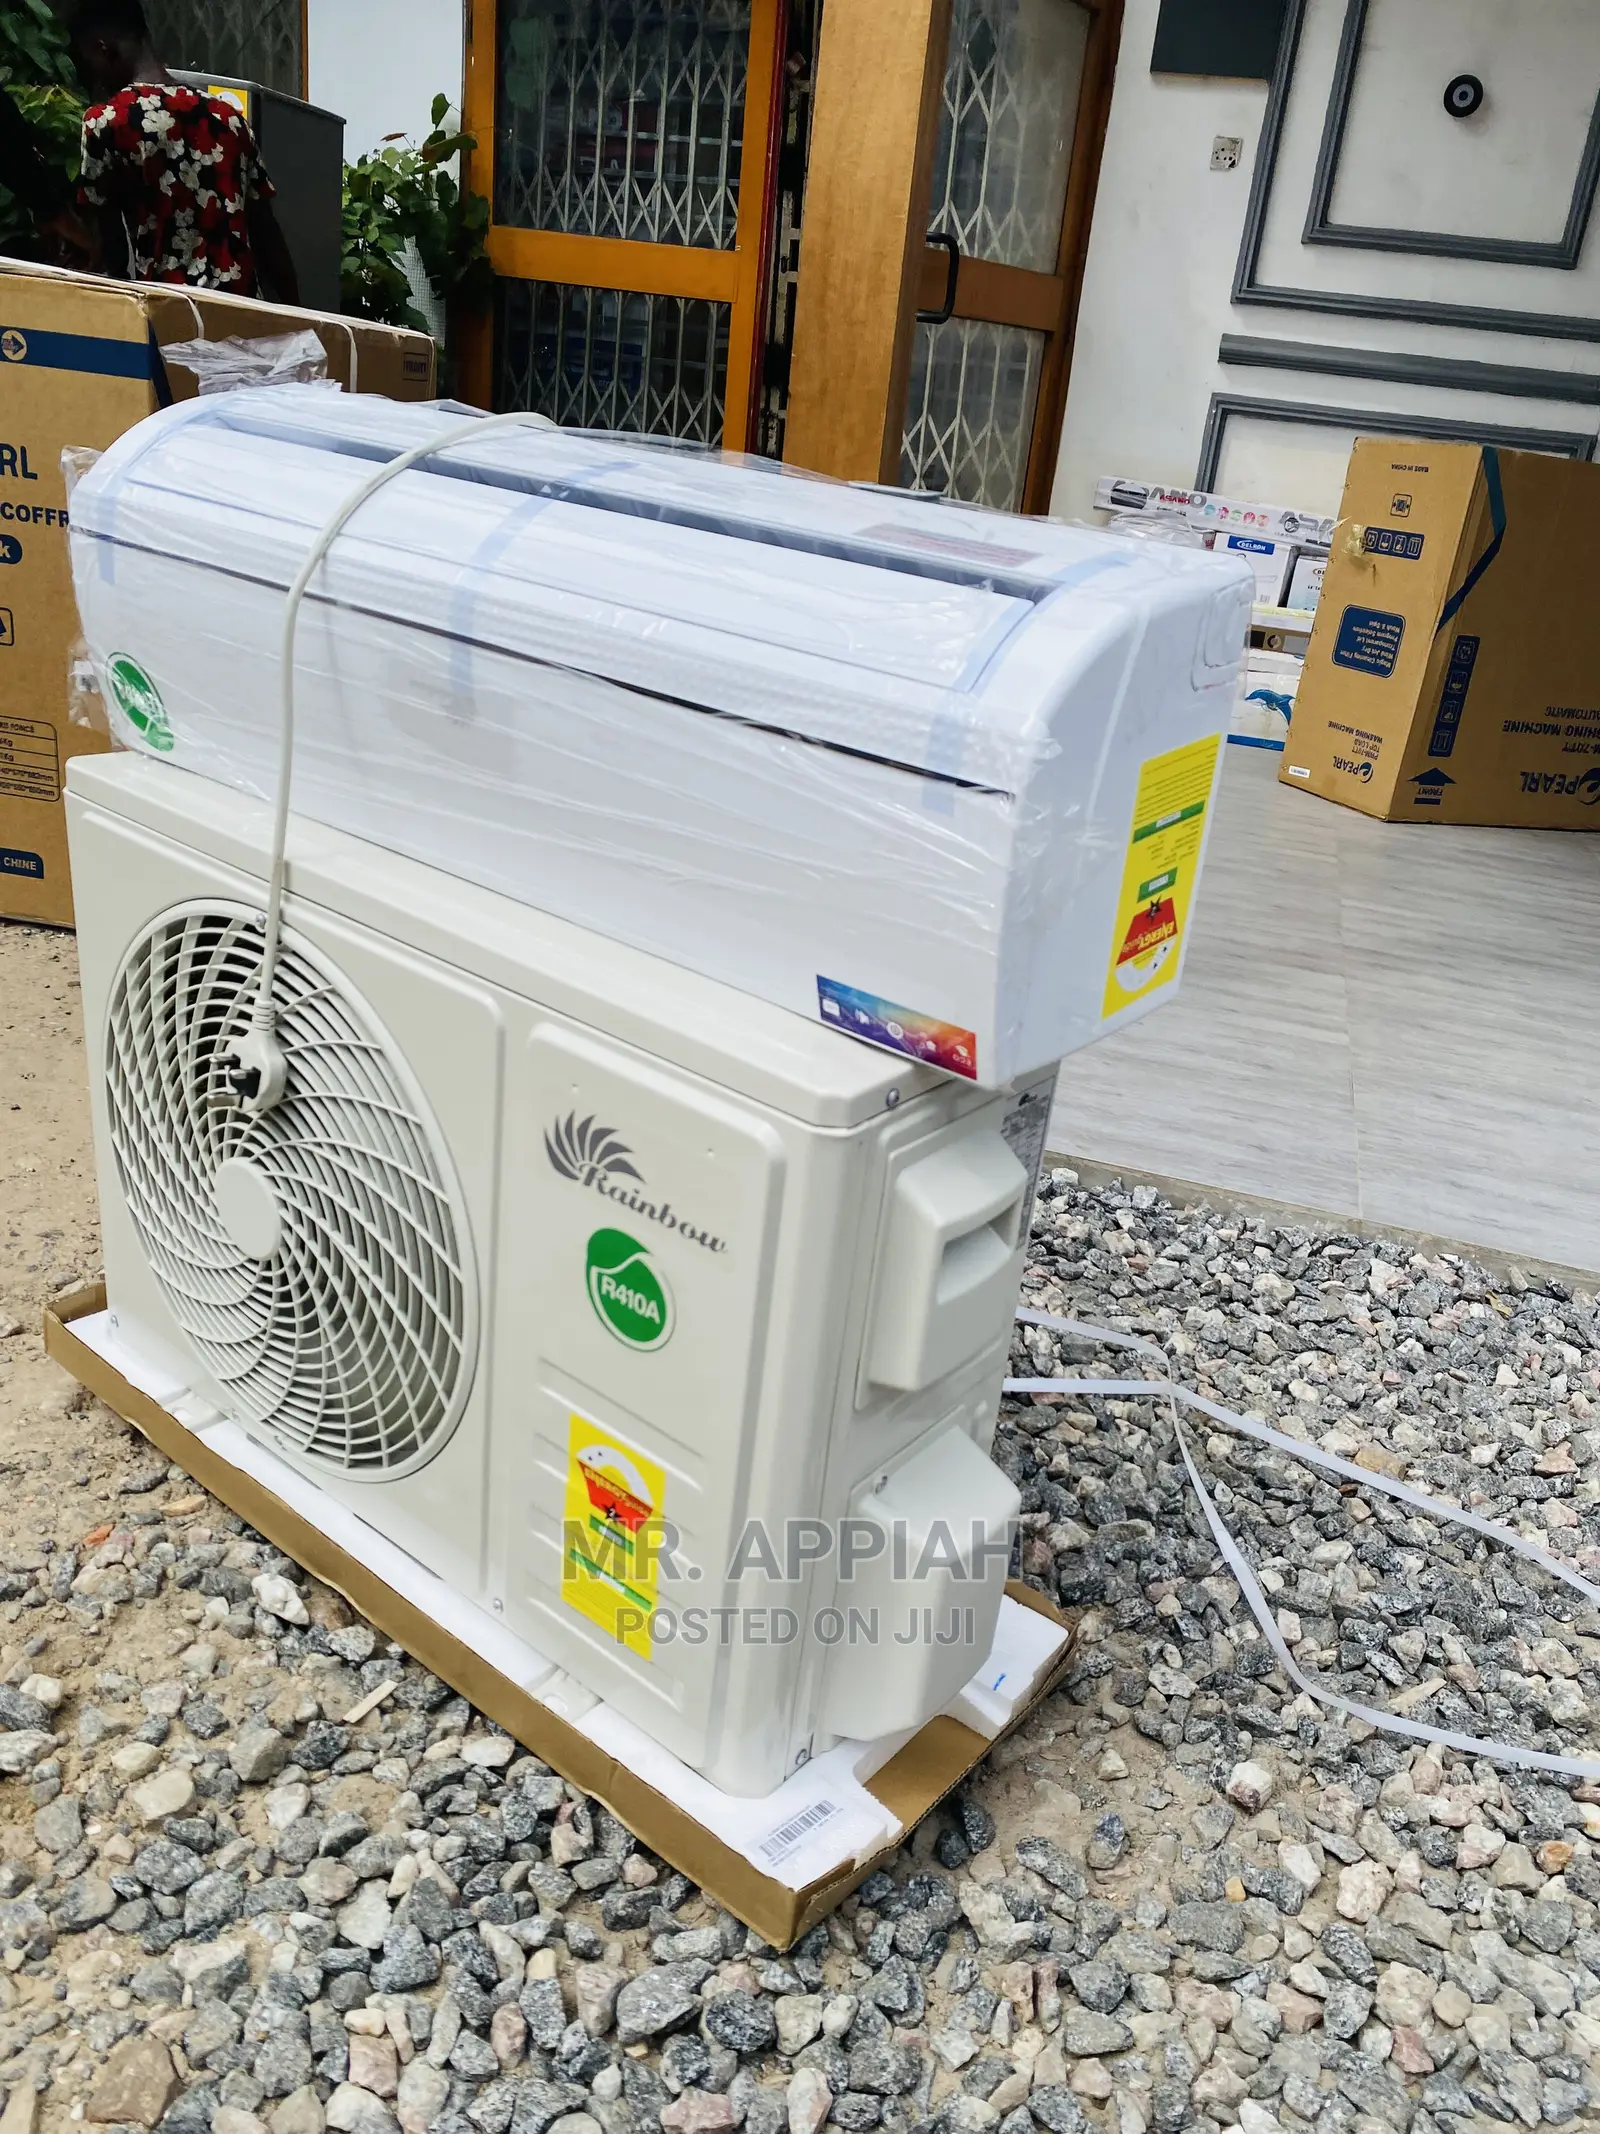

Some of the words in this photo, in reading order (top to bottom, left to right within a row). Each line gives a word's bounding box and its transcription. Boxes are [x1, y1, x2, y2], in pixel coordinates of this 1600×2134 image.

[1391, 463, 1407, 471] CHINA
[1414, 465, 1429, 473] MADE
[1241, 541, 1266, 551] DELRON
[1328, 721, 1354, 735] MACHINE
[1502, 720, 1561, 736] MACHINE
[1355, 729, 1383, 744] WASHING
[1353, 739, 1369, 749] LOAD
[1369, 743, 1380, 752] TOP
[1333, 756, 1360, 776] PEARL
[1520, 771, 1580, 795] PEARL
[1417, 787, 1444, 797] FRONT
[3, 857, 37, 871] CHINE
[579, 1163, 727, 1252] Rainbow
[601, 1275, 660, 1325] R410A
